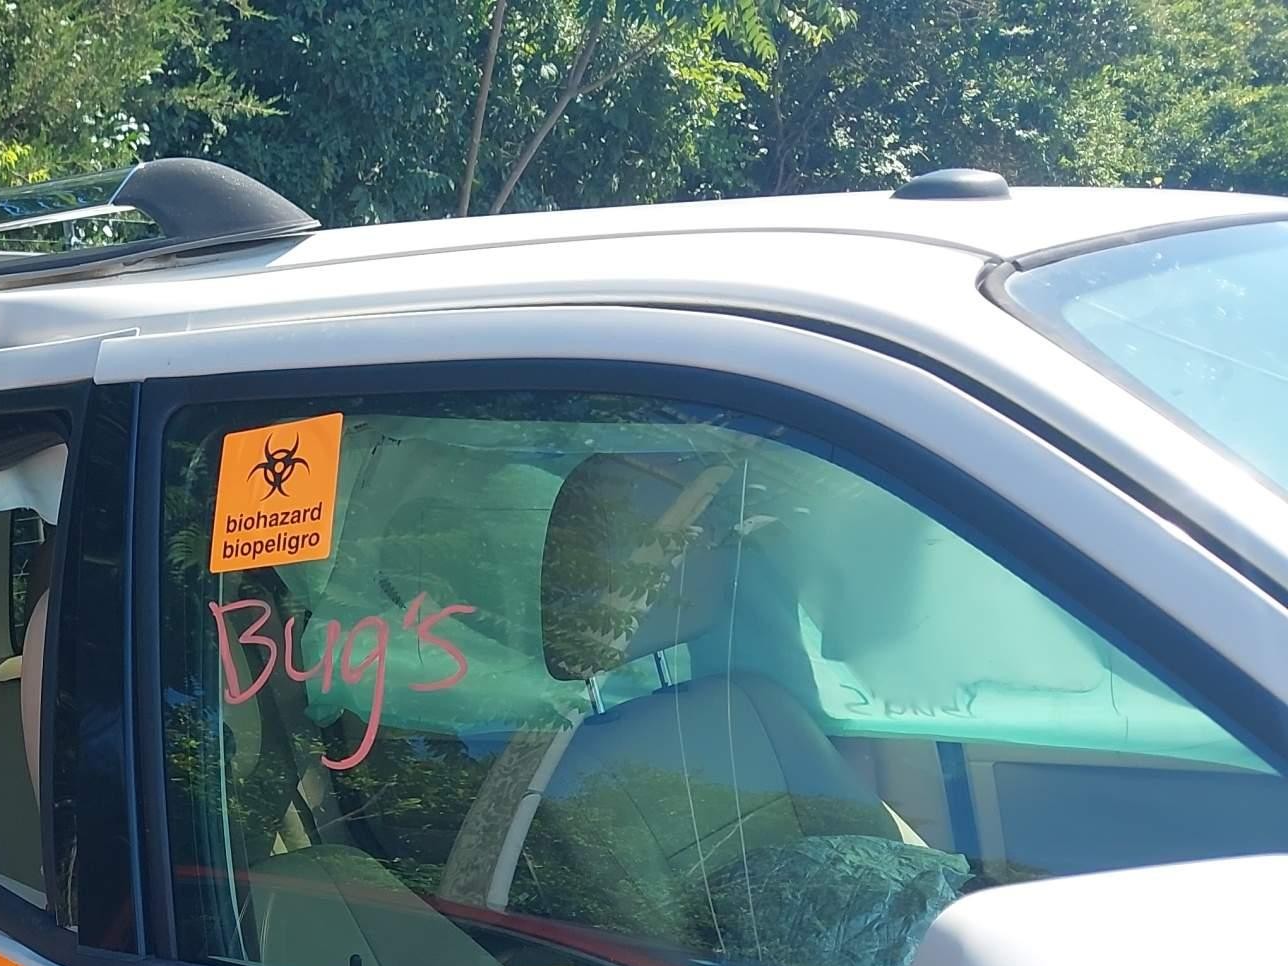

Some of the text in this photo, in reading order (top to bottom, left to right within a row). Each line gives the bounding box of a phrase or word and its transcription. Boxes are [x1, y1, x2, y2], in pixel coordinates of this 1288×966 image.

[225, 502, 323, 534] biohazard
[222, 530, 321, 560] biopeligro
[209, 592, 477, 770] Bug's
